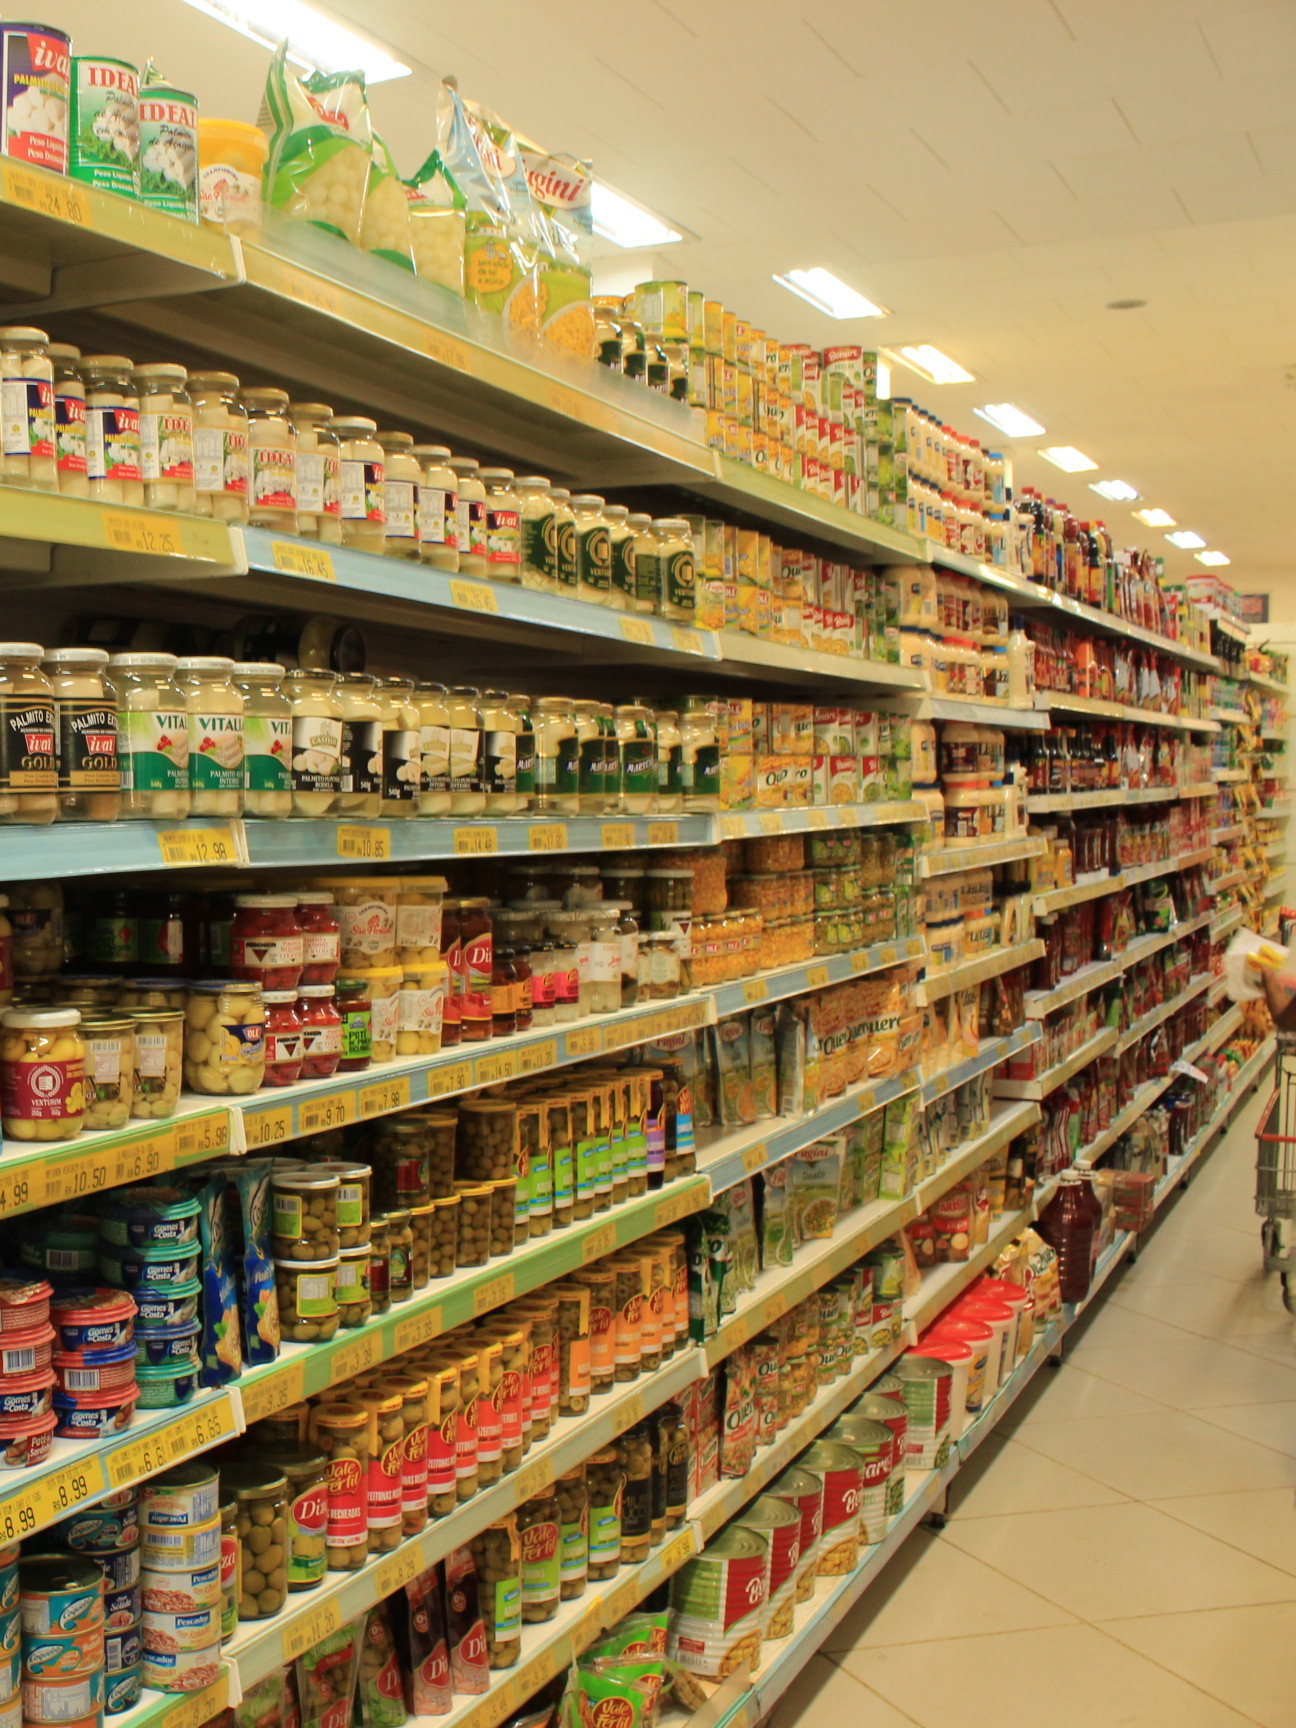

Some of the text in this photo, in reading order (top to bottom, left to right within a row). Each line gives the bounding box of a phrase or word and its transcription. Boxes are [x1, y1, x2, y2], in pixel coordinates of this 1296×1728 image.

[45, 194, 82, 222] 24.80
[140, 534, 175, 554] 12.25
[10, 709, 45, 732] PALMITO
[71, 711, 106, 733] PALMITO
[82, 756, 117, 770] GOLD
[196, 842, 228, 863] 12.98
[31, 1097, 62, 1108] VENTURIM
[326, 1106, 346, 1124] 9.70
[203, 1126, 228, 1149] 5.98
[260, 1120, 285, 1142] 10.25
[134, 1152, 160, 1177] 6.90
[73, 1166, 107, 1194] 10.50
[87, 1325, 113, 1337] Gomes
[4, 1394, 30, 1407] Gomes
[71, 1411, 99, 1423] Gomes
[196, 1415, 222, 1445] 6.65
[58, 1475, 89, 1508] 8.99
[4, 1506, 36, 1539] 8.99
[330, 1506, 361, 1520] RECHEADAS
[176, 1614, 210, 1627] Pescador
